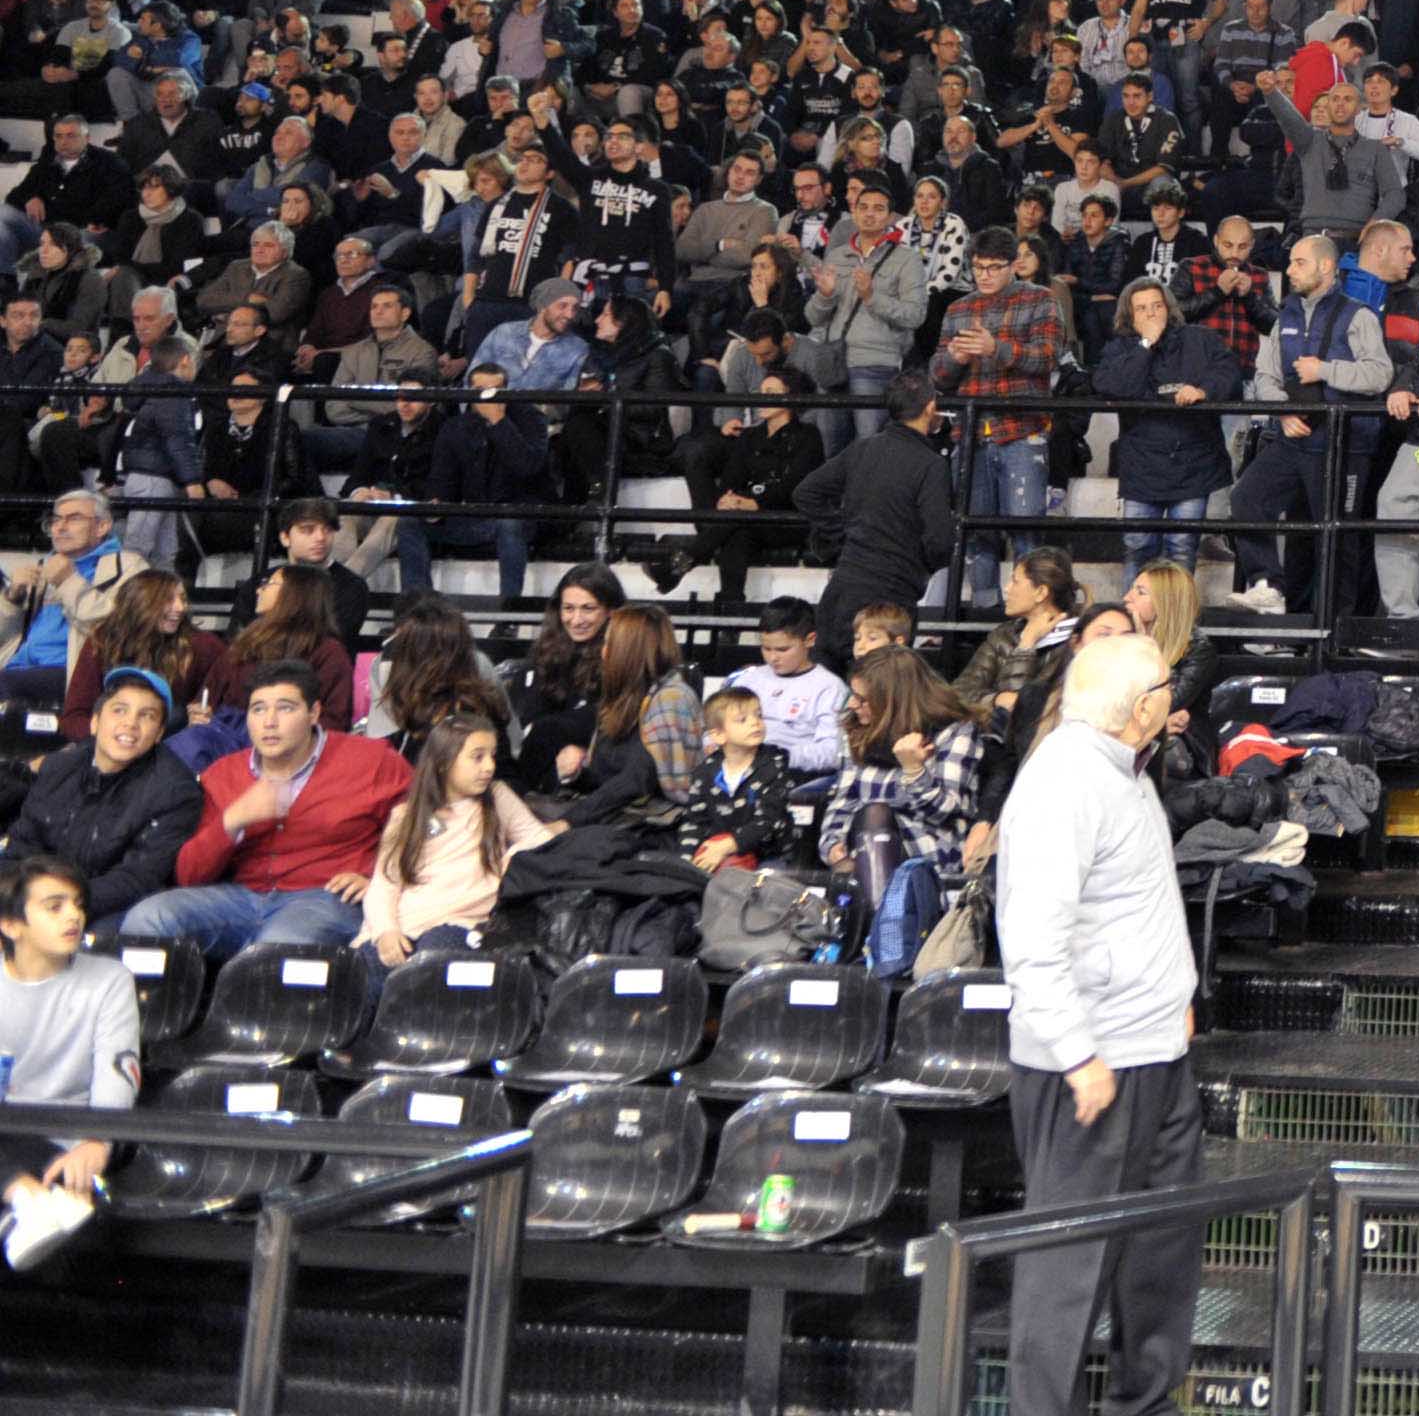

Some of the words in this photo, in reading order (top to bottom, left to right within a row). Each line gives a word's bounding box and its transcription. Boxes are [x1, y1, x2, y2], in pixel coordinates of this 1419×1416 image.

[1363, 1221, 1379, 1249] D
[1205, 1383, 1241, 1406] FILA
[1250, 1376, 1270, 1407] C
